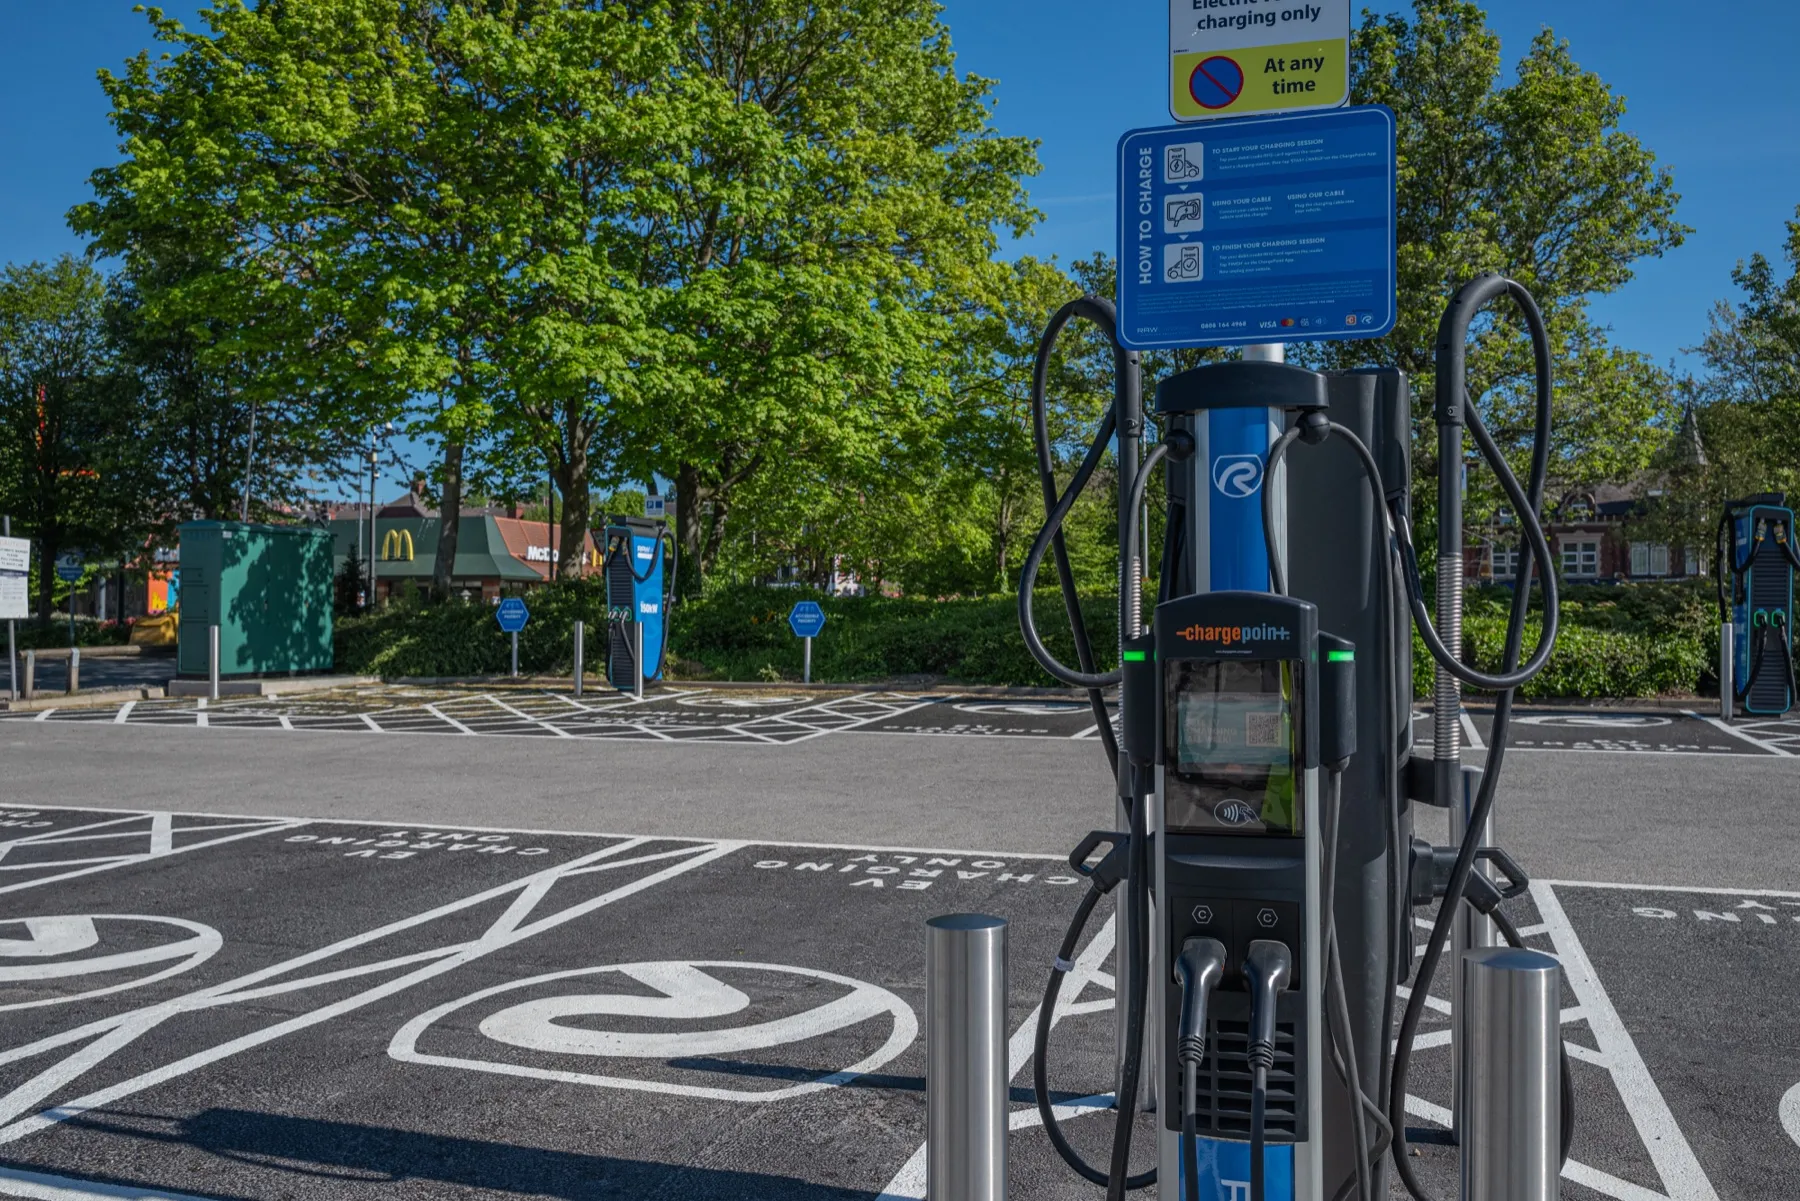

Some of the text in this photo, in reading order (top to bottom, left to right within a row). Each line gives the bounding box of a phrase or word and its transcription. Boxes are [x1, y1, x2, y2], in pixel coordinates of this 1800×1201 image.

[1197, 4, 1321, 30] charging only
[1264, 57, 1325, 73] At any
[1272, 79, 1316, 95] time
[1222, 146, 1240, 154] START
[1241, 144, 1258, 152] YOUR
[1260, 141, 1296, 150] CHARGING
[1297, 138, 1324, 147] SESSION
[1251, 196, 1271, 204] CABLE
[1325, 189, 1345, 197] CABLE
[1138, 147, 1152, 285] HOW TO CHARGE
[1262, 239, 1298, 248] CHARGING
[1299, 236, 1326, 245] SESSION
[1259, 320, 1277, 329] VISA
[378, 830, 510, 843] ONLY
[284, 834, 550, 856] CHARGING
[344, 849, 418, 859] EV
[848, 854, 1006, 869] ONLY
[752, 859, 1080, 885] CHARGING
[849, 877, 933, 891] EV
